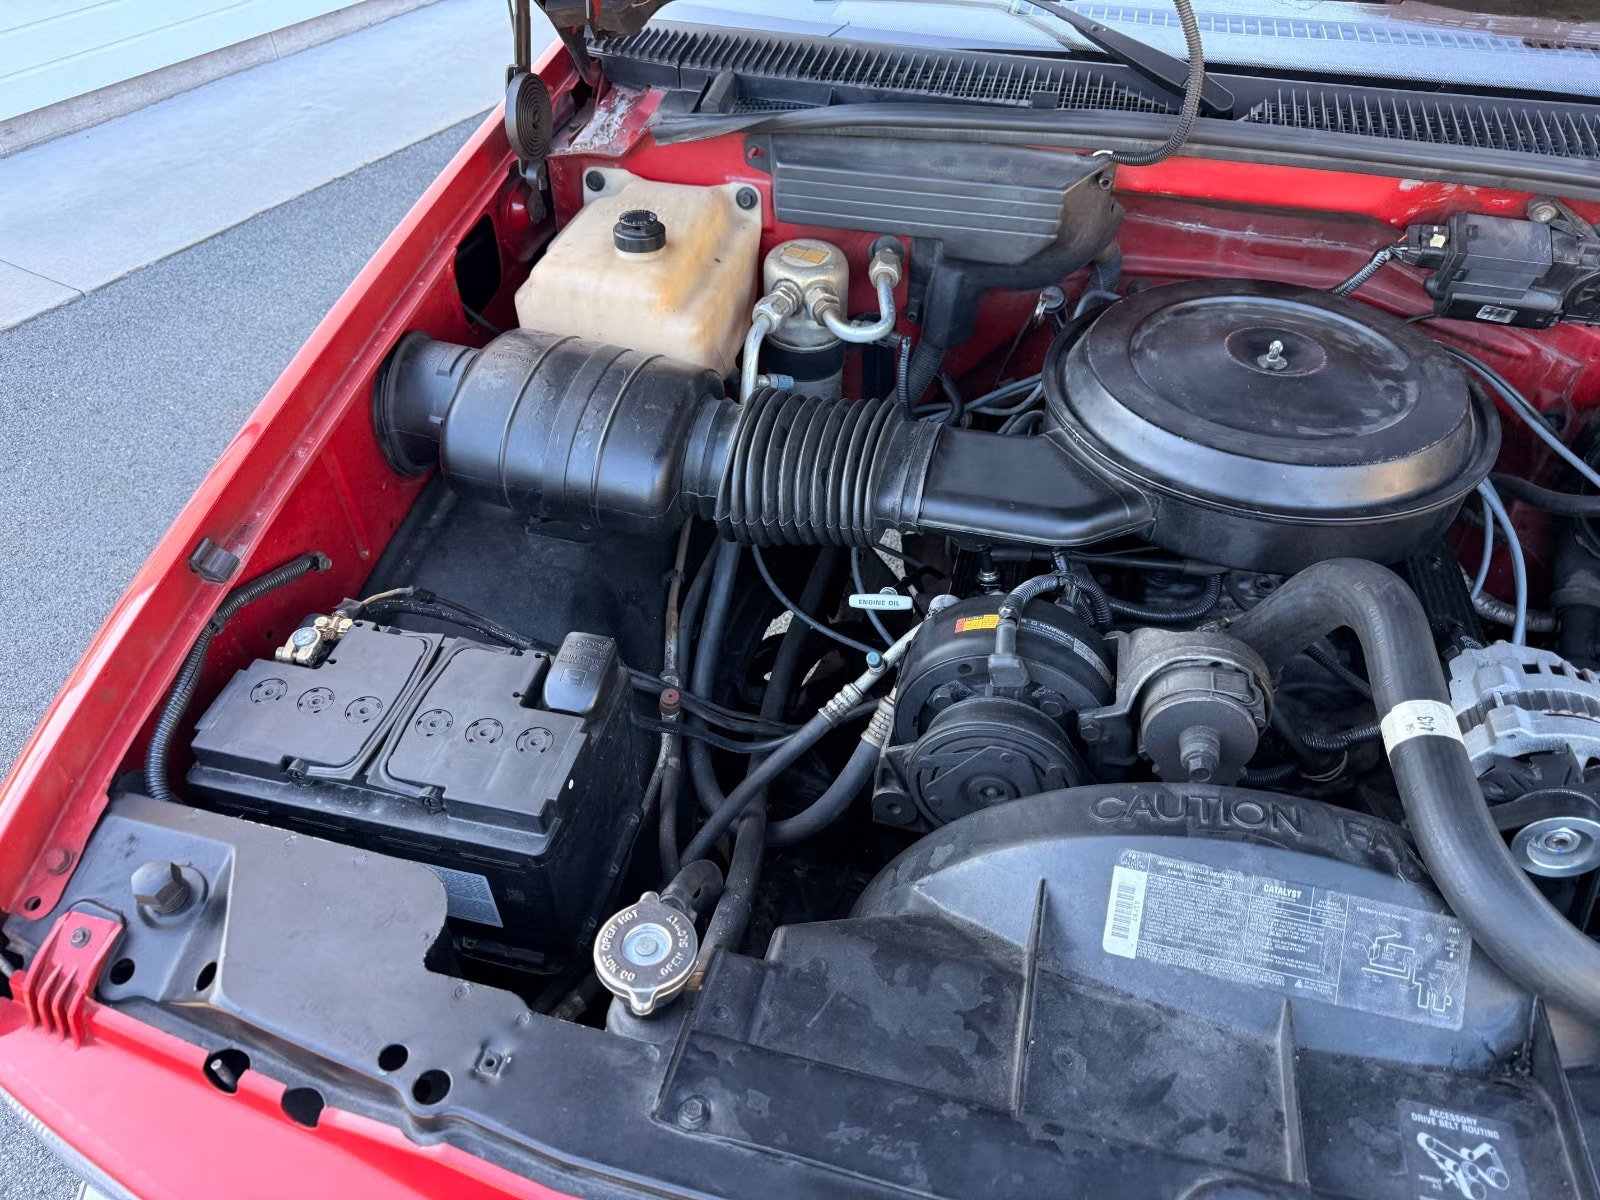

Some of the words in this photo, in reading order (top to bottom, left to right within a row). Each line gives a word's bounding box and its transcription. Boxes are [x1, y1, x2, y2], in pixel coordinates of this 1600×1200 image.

[1089, 793, 1304, 837] CAUTION
[1263, 883, 1302, 900] CATALYST
[618, 909, 638, 925] HOT
[601, 924, 618, 951] OPEN
[666, 914, 689, 948] SLOWLY
[602, 954, 620, 974] NOT
[660, 952, 684, 977] OPEN
[620, 969, 636, 982] DO
[1411, 1112, 1437, 1126] DRIVE
[1439, 1119, 1459, 1131] BELT
[1462, 1124, 1500, 1140] ROUTING
[1429, 1108, 1478, 1126] ACCESSORY
